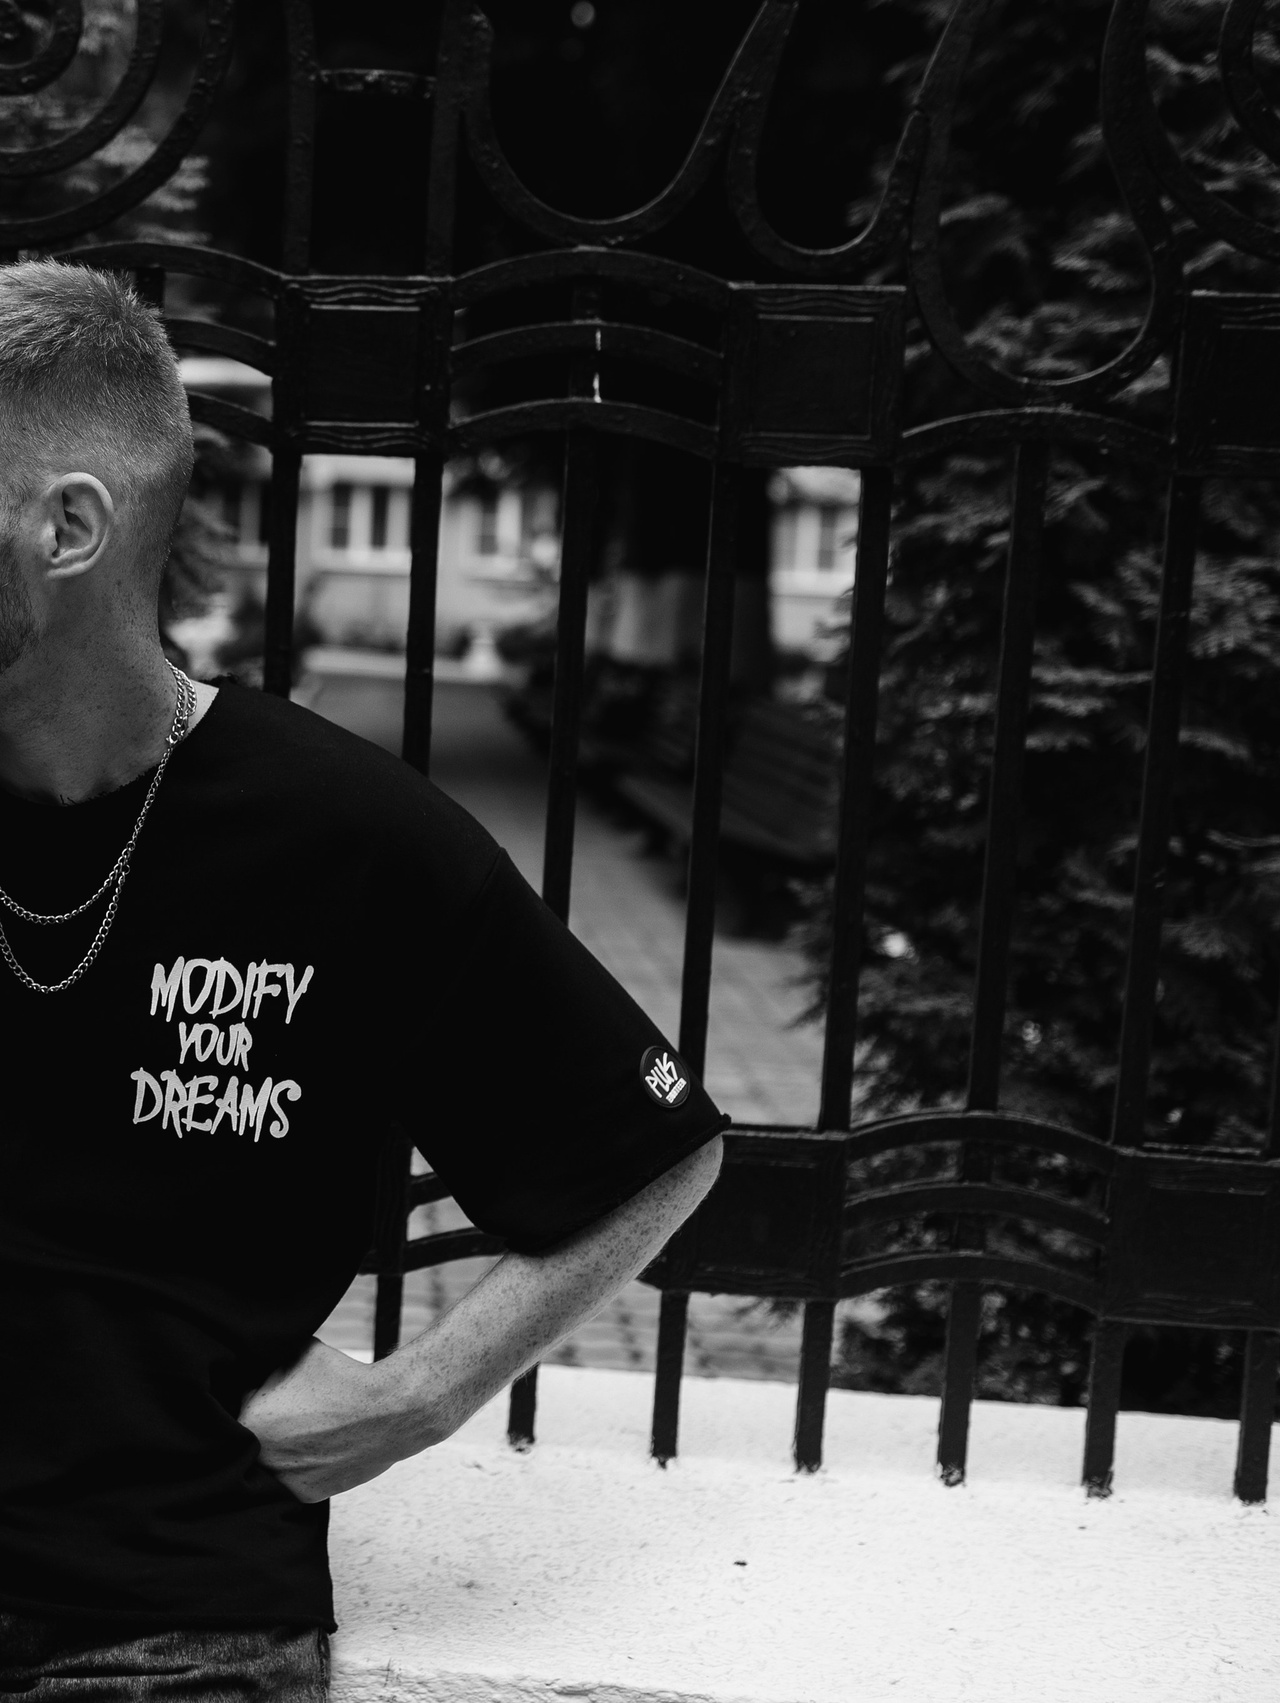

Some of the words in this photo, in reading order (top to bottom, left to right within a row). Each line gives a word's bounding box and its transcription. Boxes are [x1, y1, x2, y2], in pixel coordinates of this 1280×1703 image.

[150, 955, 315, 1024] MODIFY
[178, 1021, 253, 1072] YOUR
[645, 1052, 679, 1099] PLUS
[130, 1067, 302, 1143] DREAMS
